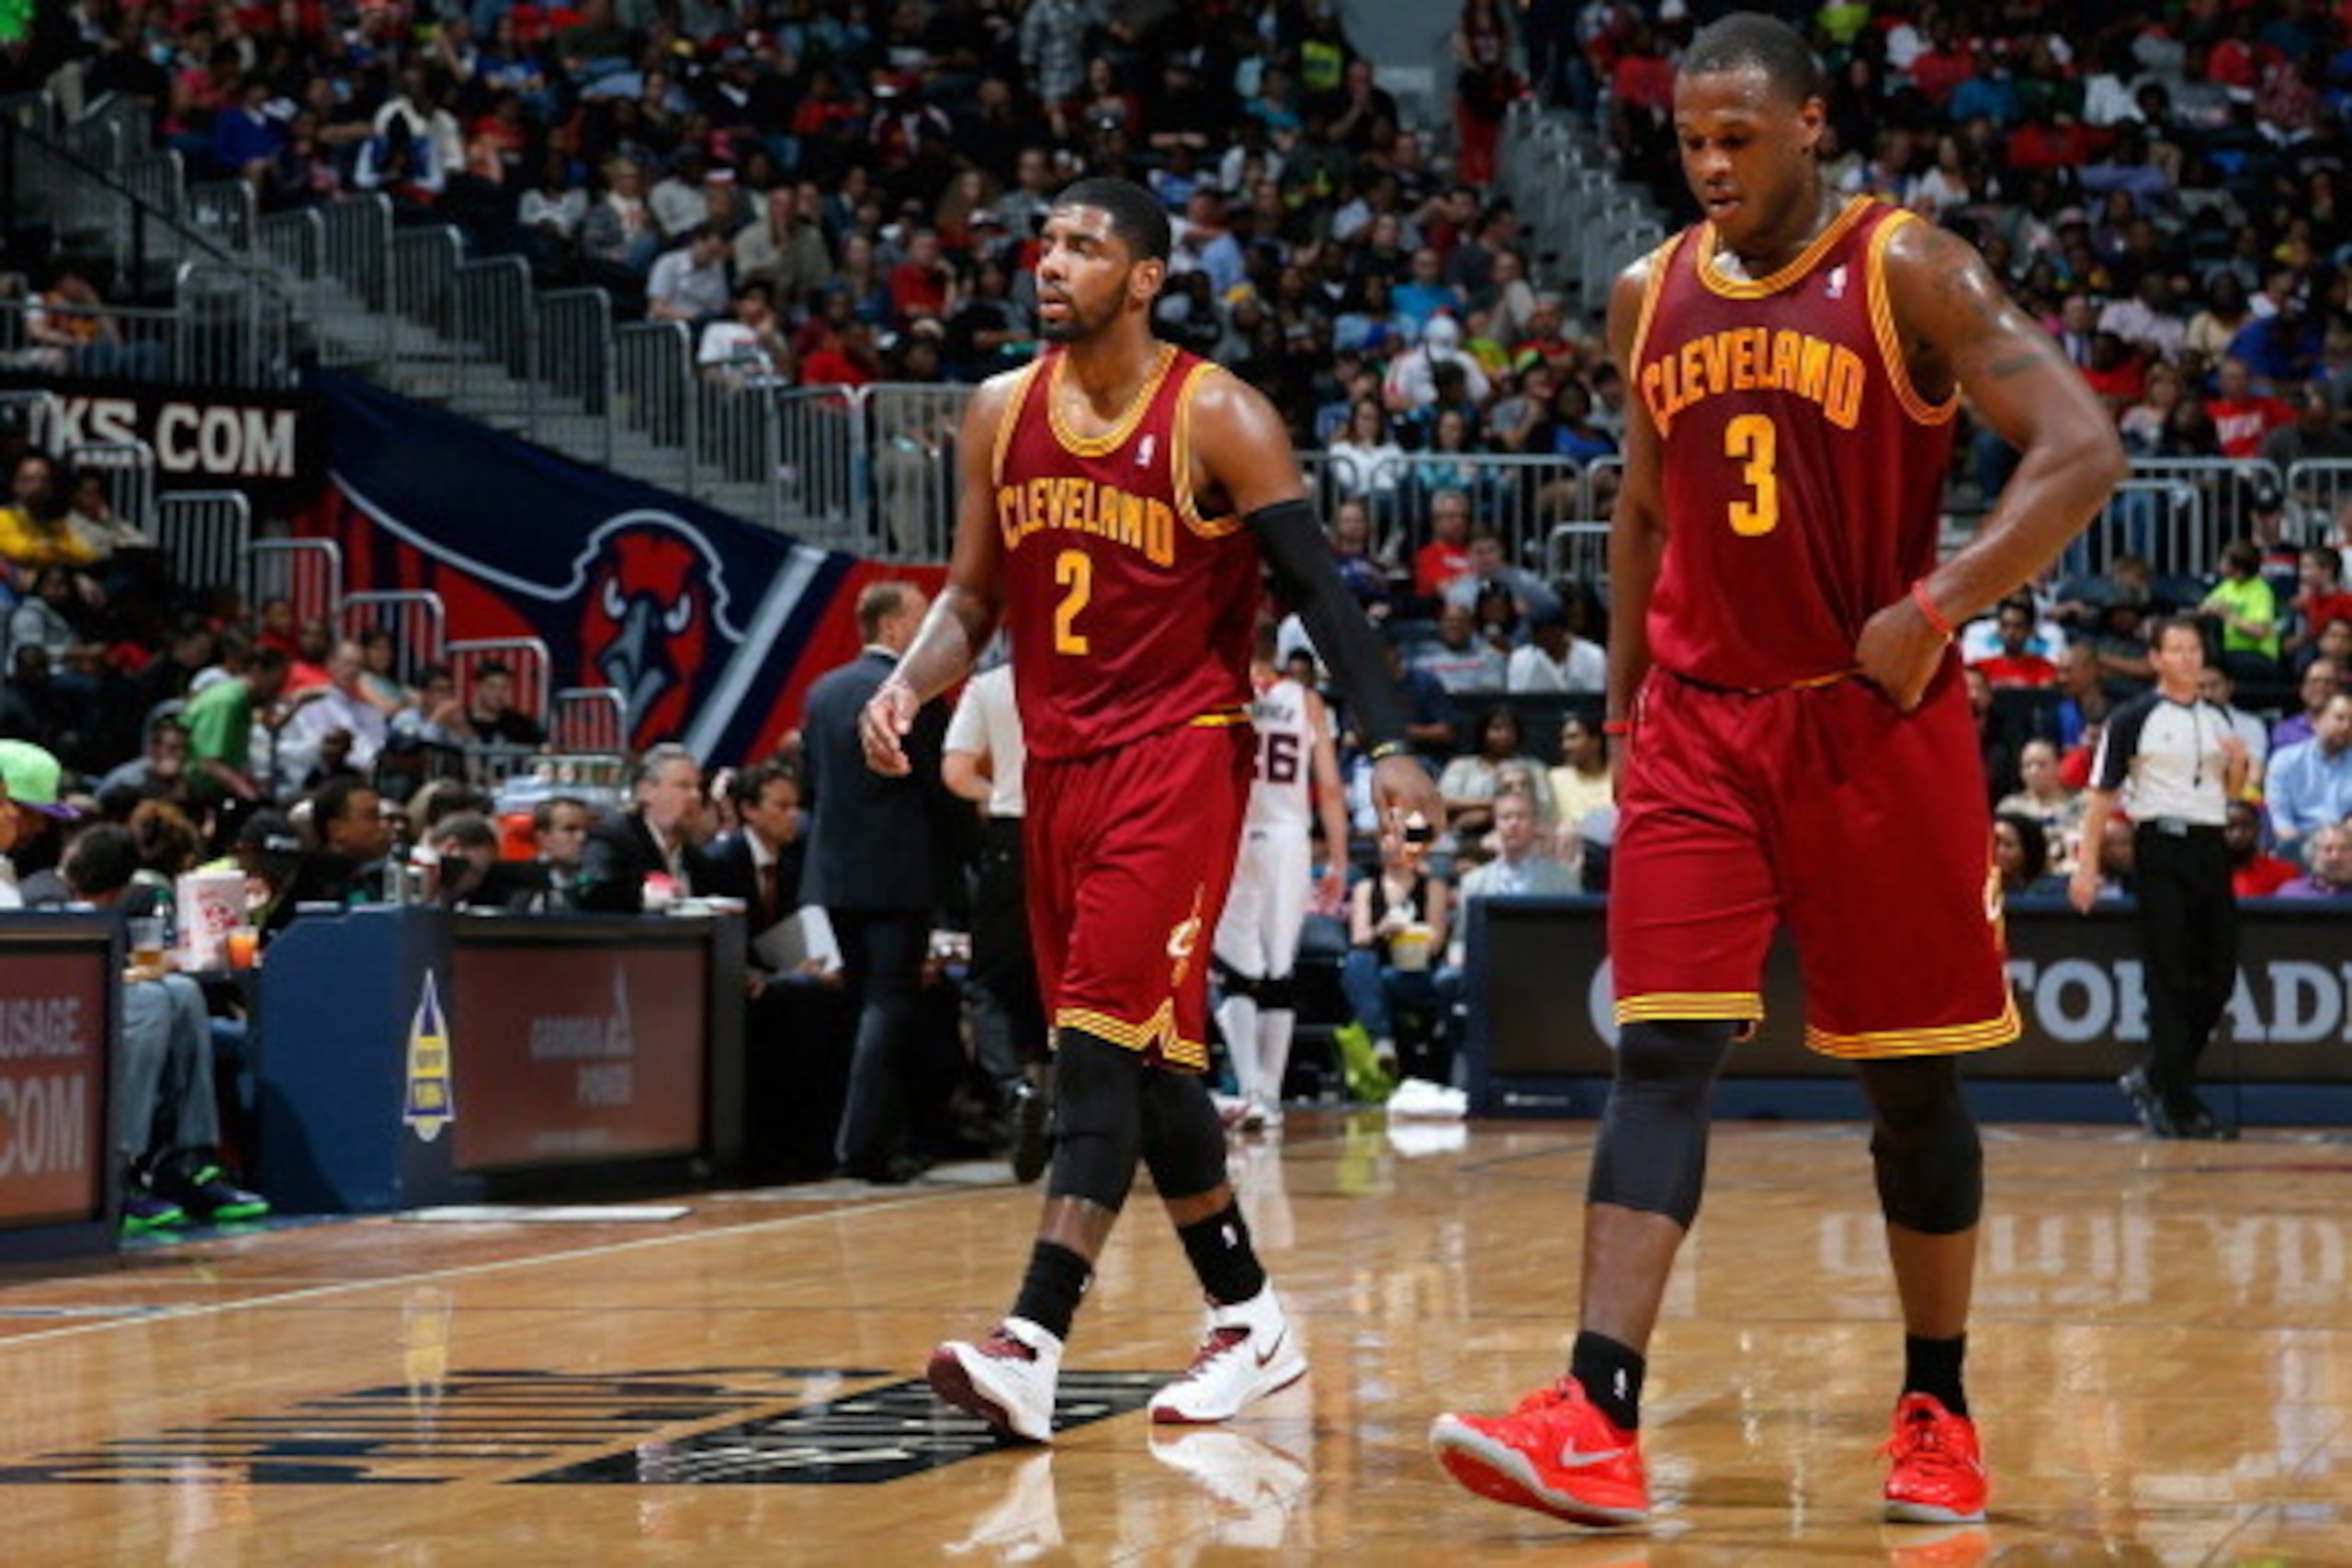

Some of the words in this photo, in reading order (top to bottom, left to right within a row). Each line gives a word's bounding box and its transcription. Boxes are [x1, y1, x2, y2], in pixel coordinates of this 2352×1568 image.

[1641, 327, 1866, 440] CLEVELAND
[997, 477, 1174, 569] CLEVELAND
[1724, 413, 1779, 536] 3
[1056, 548, 1092, 656] 2
